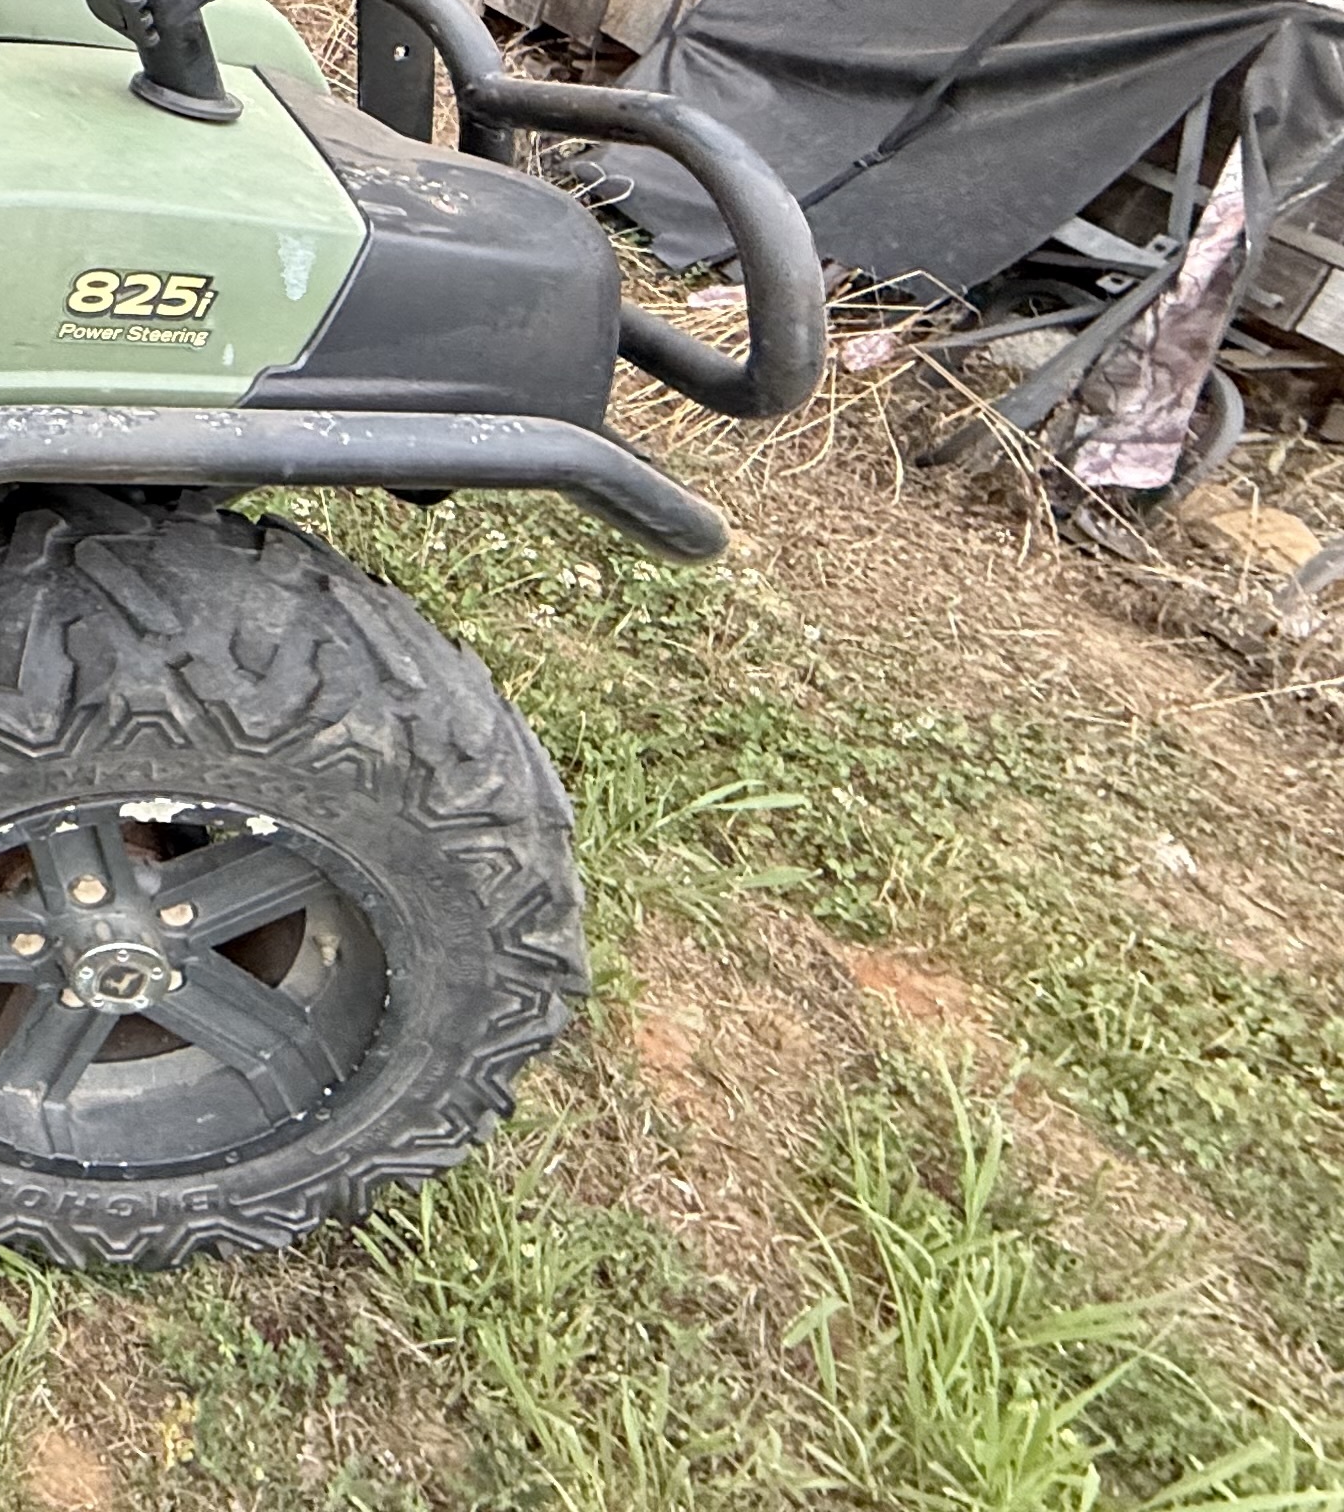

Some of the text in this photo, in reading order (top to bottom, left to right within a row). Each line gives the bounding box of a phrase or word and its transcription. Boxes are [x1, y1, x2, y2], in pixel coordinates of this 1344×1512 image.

[67, 269, 215, 319] 825i
[58, 323, 209, 348] Power Steering
